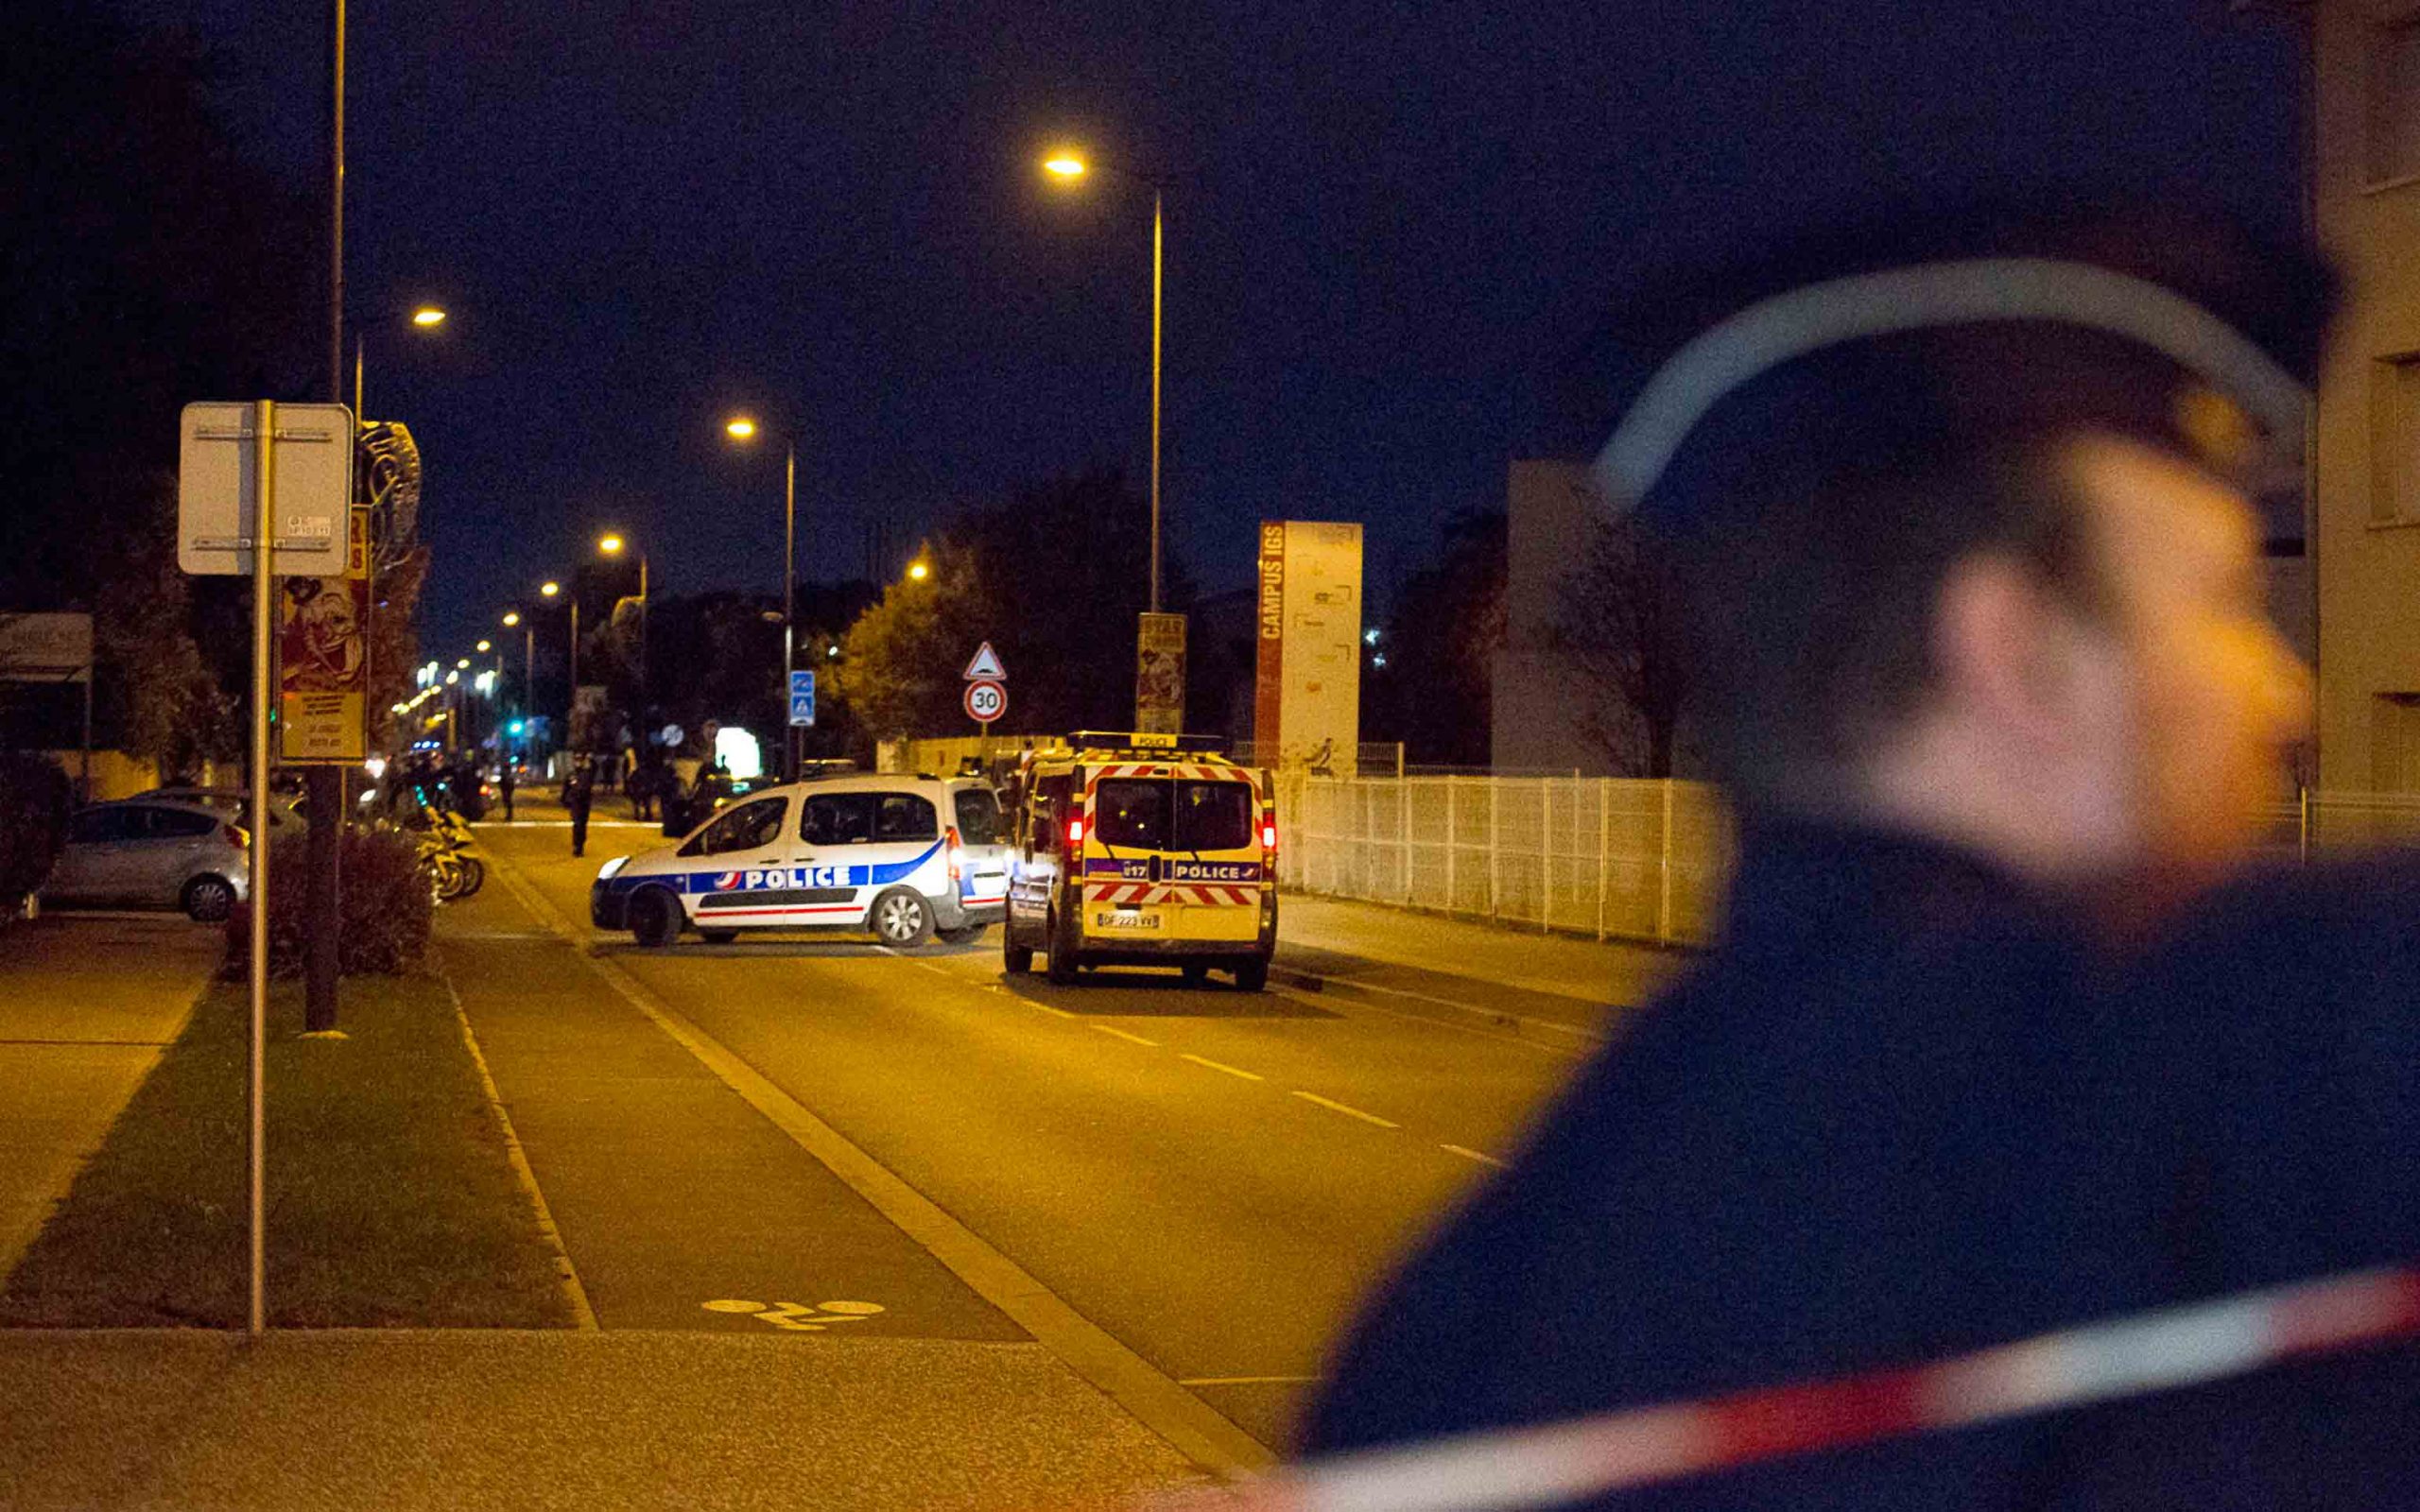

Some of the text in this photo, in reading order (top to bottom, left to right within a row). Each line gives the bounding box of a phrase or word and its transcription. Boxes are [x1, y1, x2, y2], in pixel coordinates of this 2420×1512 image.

[1263, 525, 1284, 640] CAMPUS IGS
[975, 692, 997, 708] 30
[1138, 736, 1167, 747] POLICE
[746, 867, 850, 889] POLICE
[1177, 866, 1239, 880] POLICE
